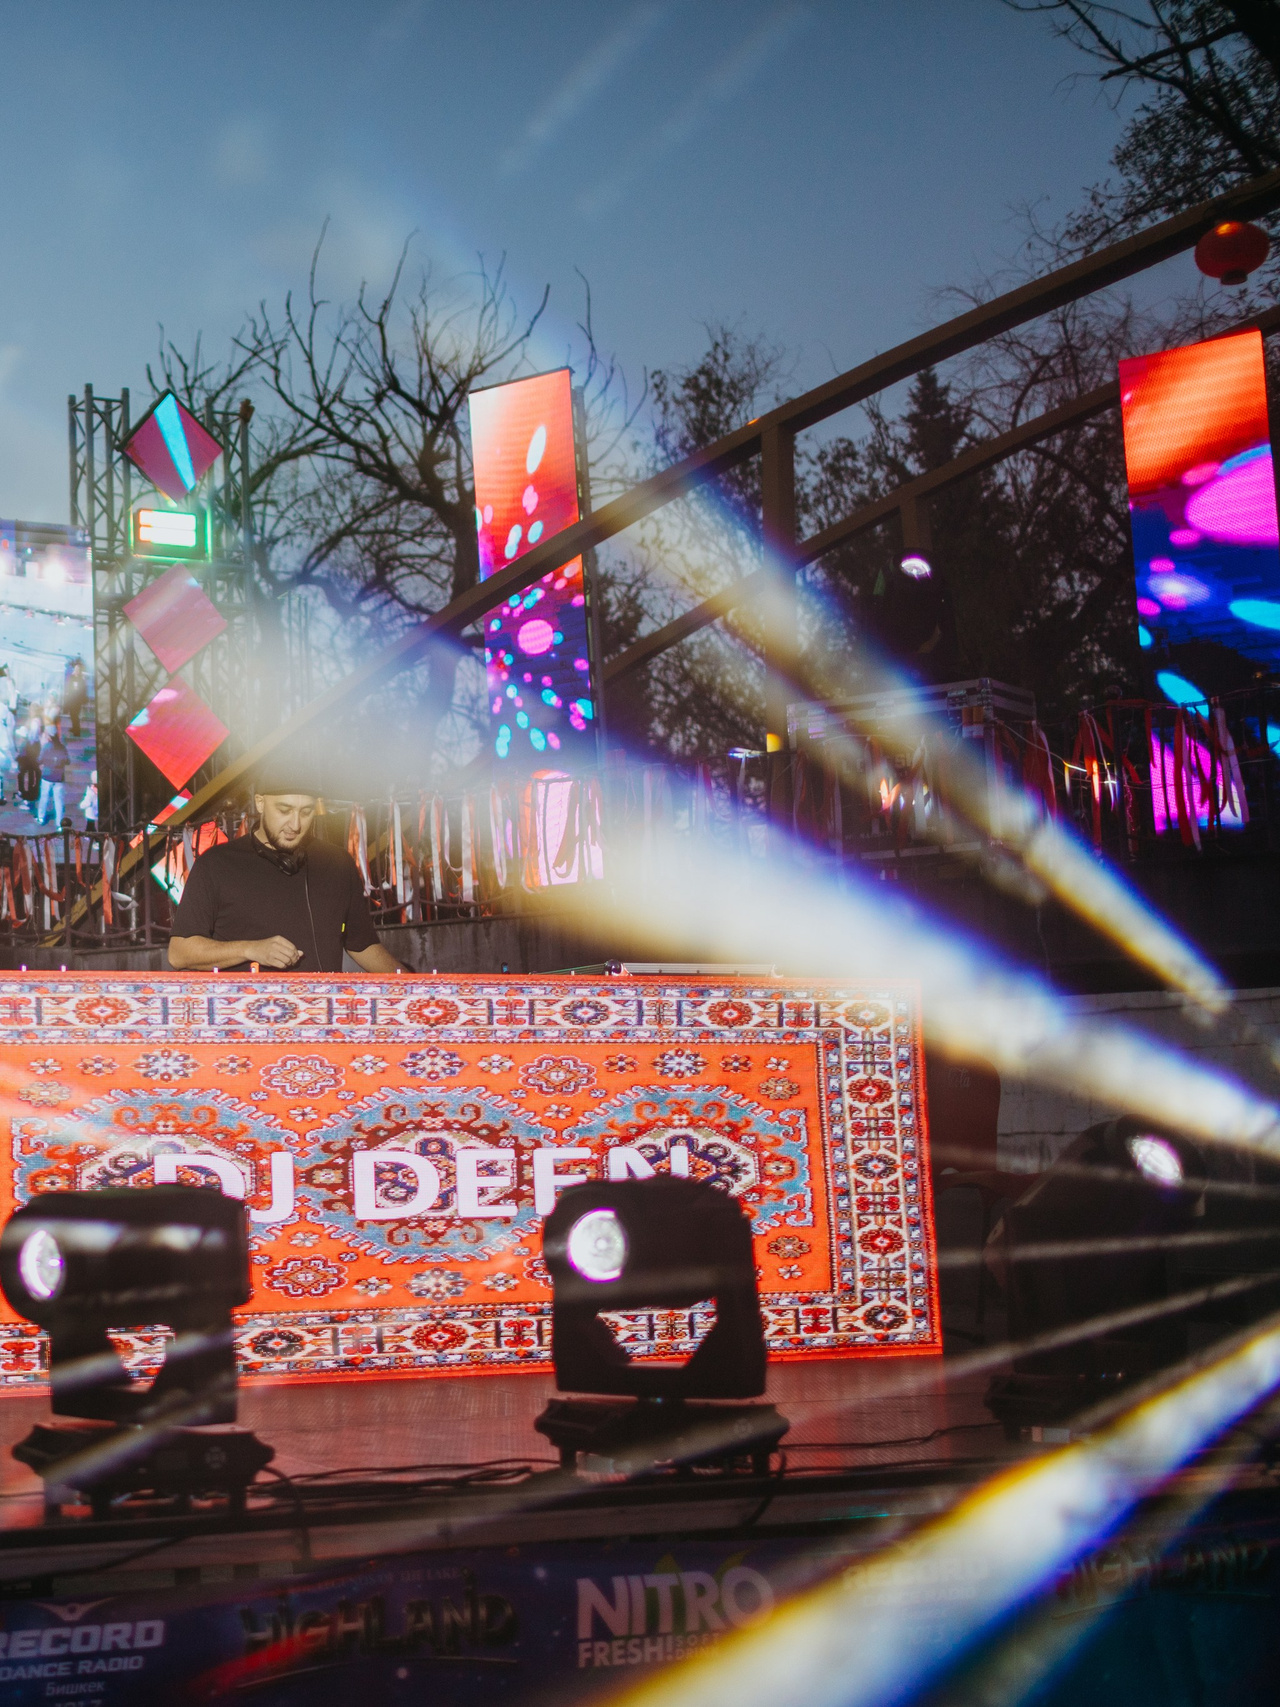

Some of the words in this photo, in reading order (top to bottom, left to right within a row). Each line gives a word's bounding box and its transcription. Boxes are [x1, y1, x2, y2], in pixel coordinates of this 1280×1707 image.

[154, 1152, 295, 1223] DJ
[240, 1578, 519, 1660] HIGHLAND
[576, 1566, 775, 1639] NITRO
[577, 1635, 673, 1668] FRESH!
[674, 1632, 721, 1649] SOFT
[77, 1654, 144, 1675] RADIO
[45, 1680, 106, 1698] Бишкек
